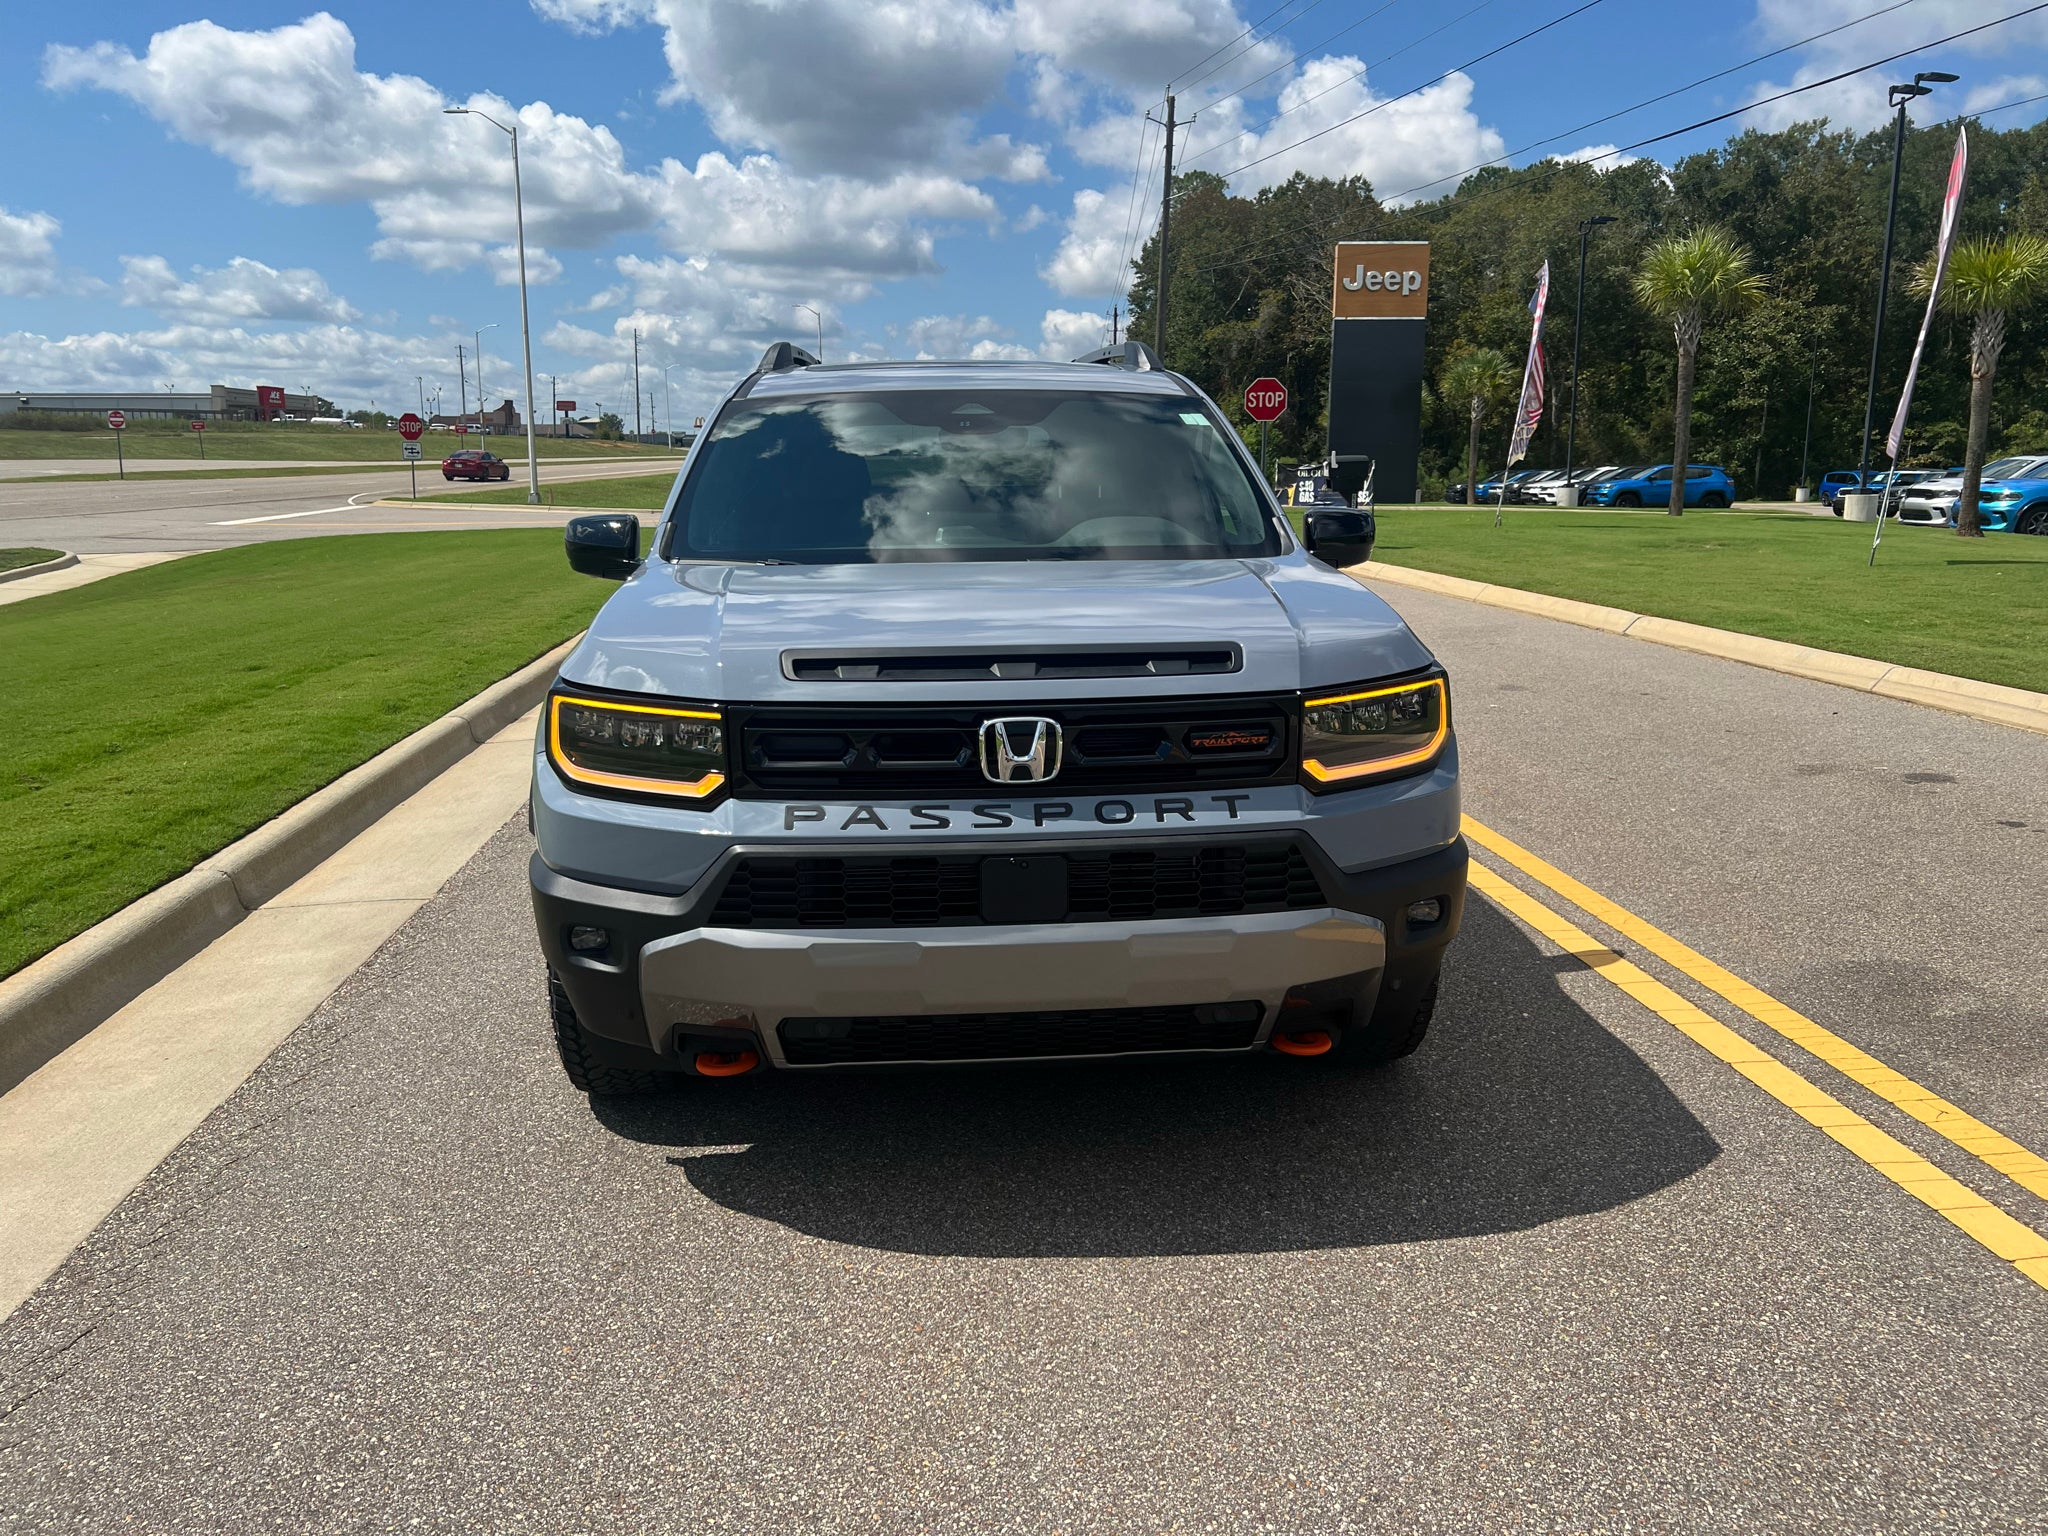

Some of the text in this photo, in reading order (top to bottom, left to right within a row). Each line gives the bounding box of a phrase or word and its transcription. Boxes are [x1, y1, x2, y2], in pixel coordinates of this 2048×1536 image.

[1343, 265, 1422, 295] Jeep
[1248, 391, 1284, 407] STOP
[400, 421, 422, 433] STOP
[1298, 491, 1315, 503] GAS
[1193, 735, 1268, 747] TRAILSPORT
[783, 795, 1250, 831] PASSPORT
